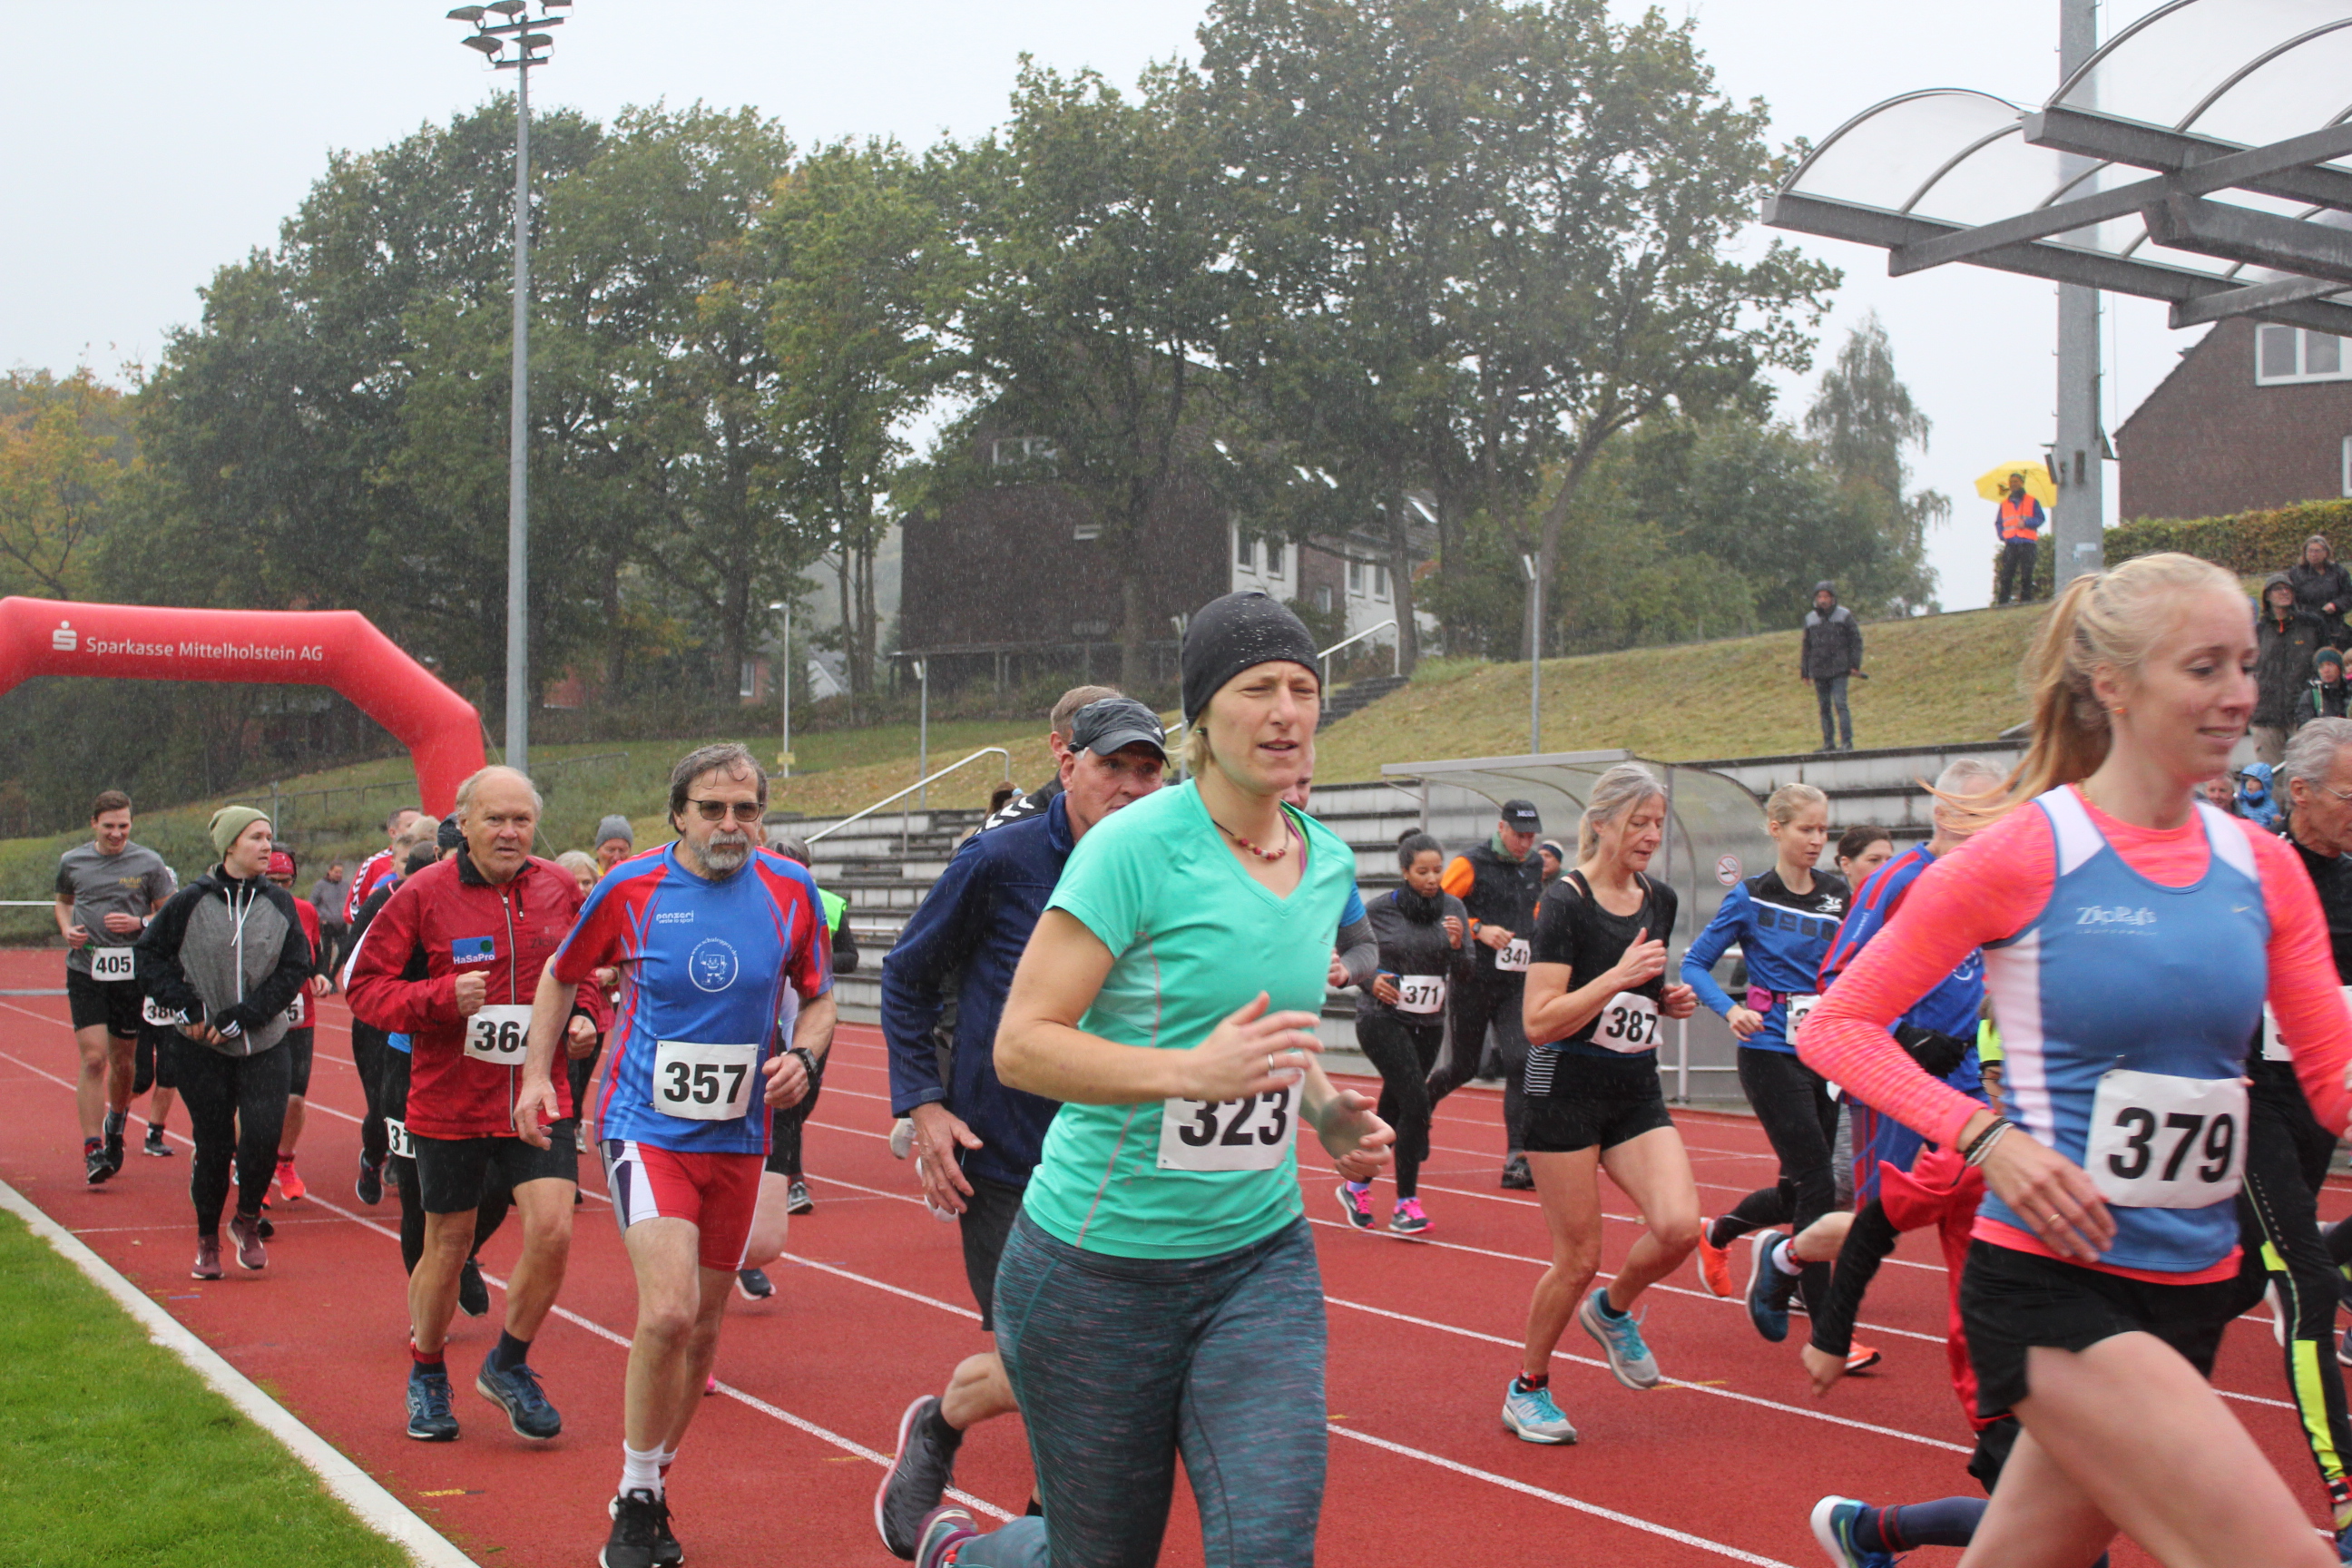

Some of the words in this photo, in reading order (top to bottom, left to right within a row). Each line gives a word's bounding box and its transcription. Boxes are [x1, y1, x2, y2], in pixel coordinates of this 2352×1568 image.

[86, 636, 174, 657] Sparkasse
[179, 642, 296, 661] Mittelholstein
[299, 645, 323, 661] AG
[96, 956, 132, 974] 405
[453, 953, 495, 965] HaSaPro
[1501, 946, 1528, 965] 341
[1404, 985, 1439, 1005] 371
[1605, 1006, 1658, 1044] 387
[663, 1061, 748, 1105] 357
[1179, 1085, 1290, 1147] 323
[2107, 1107, 2234, 1183] 379
